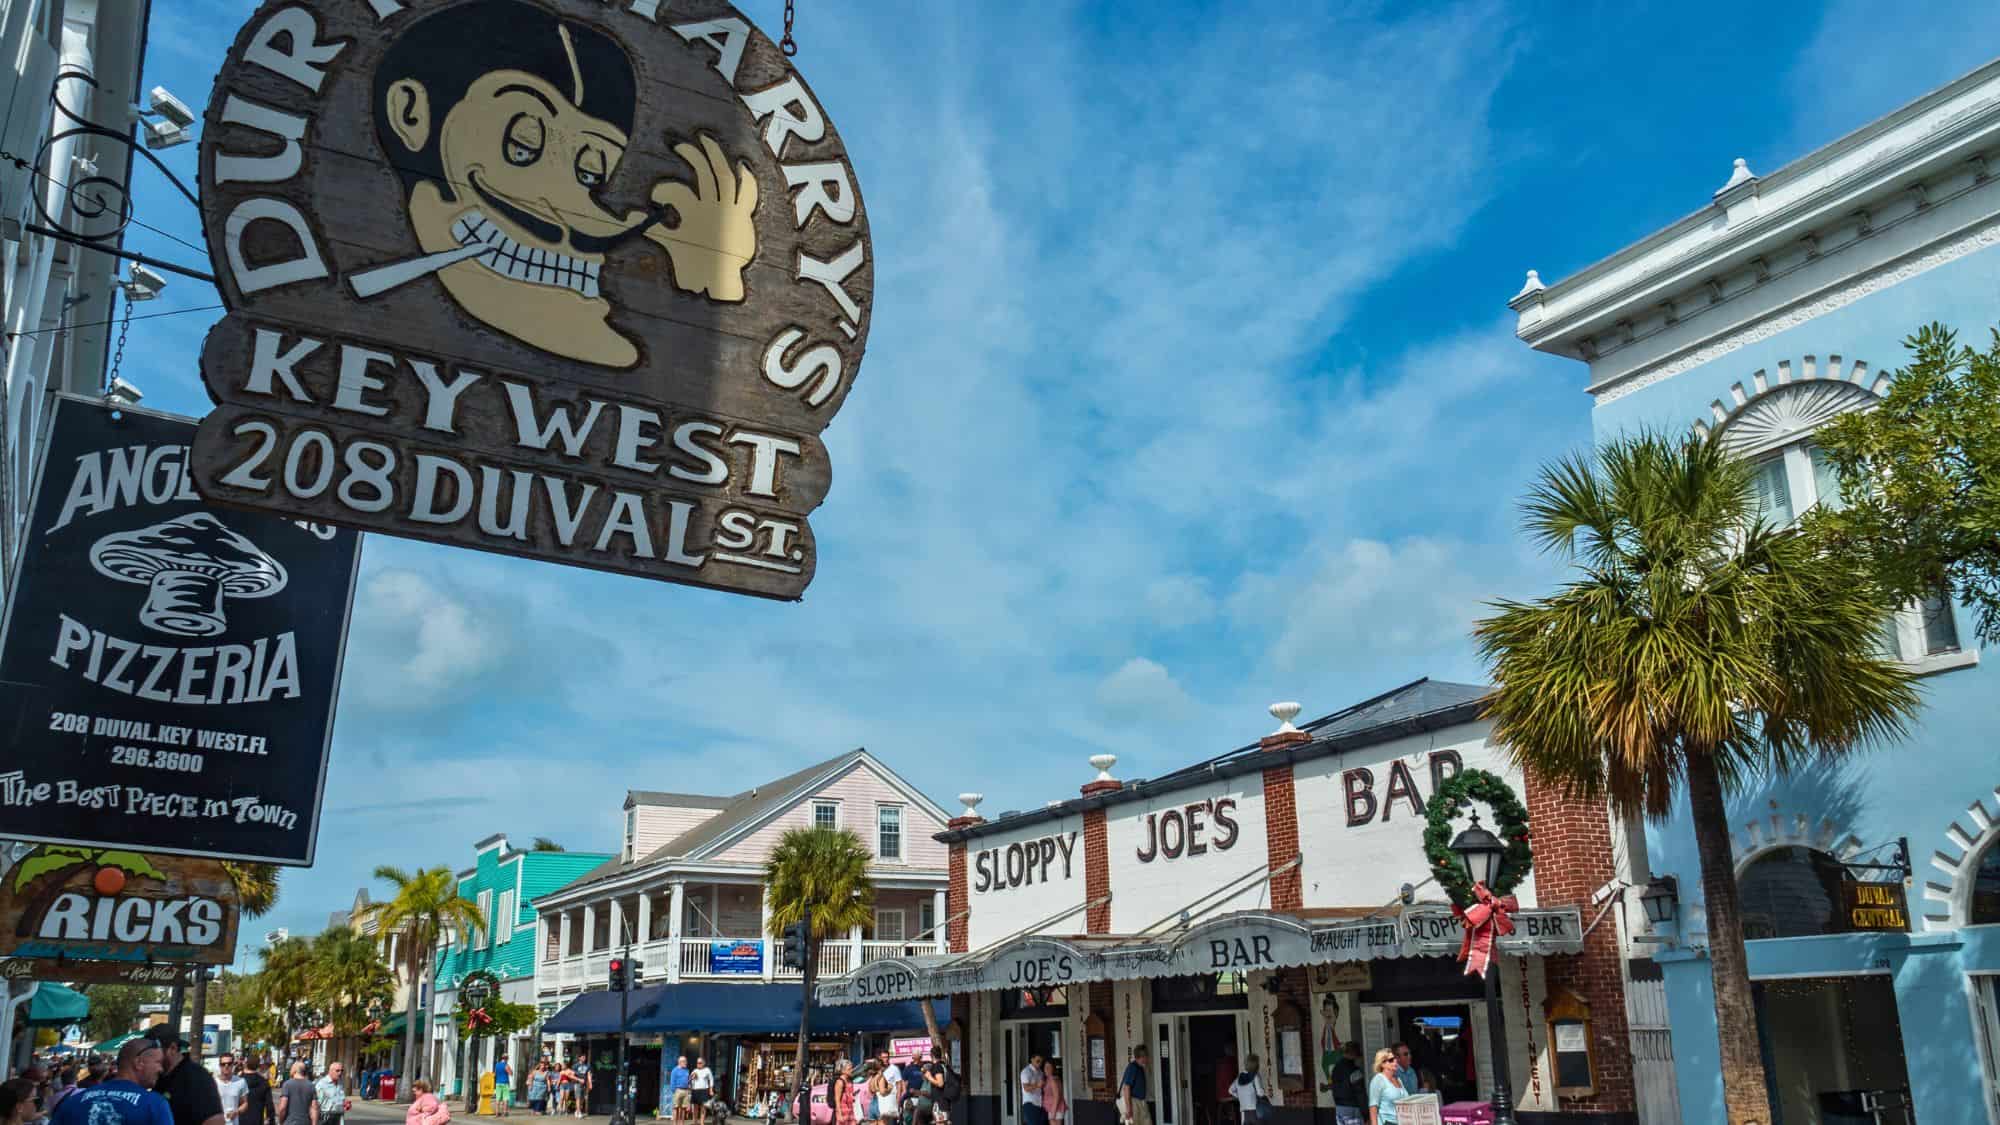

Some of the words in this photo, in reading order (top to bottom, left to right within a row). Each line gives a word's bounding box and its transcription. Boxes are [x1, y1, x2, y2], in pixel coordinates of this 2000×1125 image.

[215, 0, 402, 296] DUR
[629, 0, 865, 406] ARRY'S
[244, 328, 481, 433] KEY
[500, 380, 801, 499] WEST
[46, 444, 200, 534] ANGE
[219, 422, 396, 513] 208
[407, 453, 705, 569] DUVAL
[714, 511, 802, 560] ST.
[50, 613, 301, 705] PIZZERIA
[49, 712, 89, 734] 208
[111, 745, 204, 773] 296.3600
[0, 770, 51, 806] The
[975, 831, 1078, 894] SLOPPY
[1136, 797, 1239, 863] JOE'S
[1856, 886, 1894, 905] DUVAL
[39, 893, 223, 945] RICK'S
[1411, 917, 1462, 940] SLOPP
[1527, 917, 1565, 937] BAR
[1852, 908, 1905, 928] CENTRAL
[1209, 934, 1275, 968] BAR
[1310, 928, 1361, 952] DRAUGHT
[1367, 924, 1396, 946] BEER
[130, 968, 151, 982] Key
[857, 971, 914, 997] SLOPPY
[1009, 955, 1073, 984] JOE'S
[1519, 956, 1542, 1105] NTERTAINMENT
[1262, 1005, 1275, 1099] COCKTAILS
